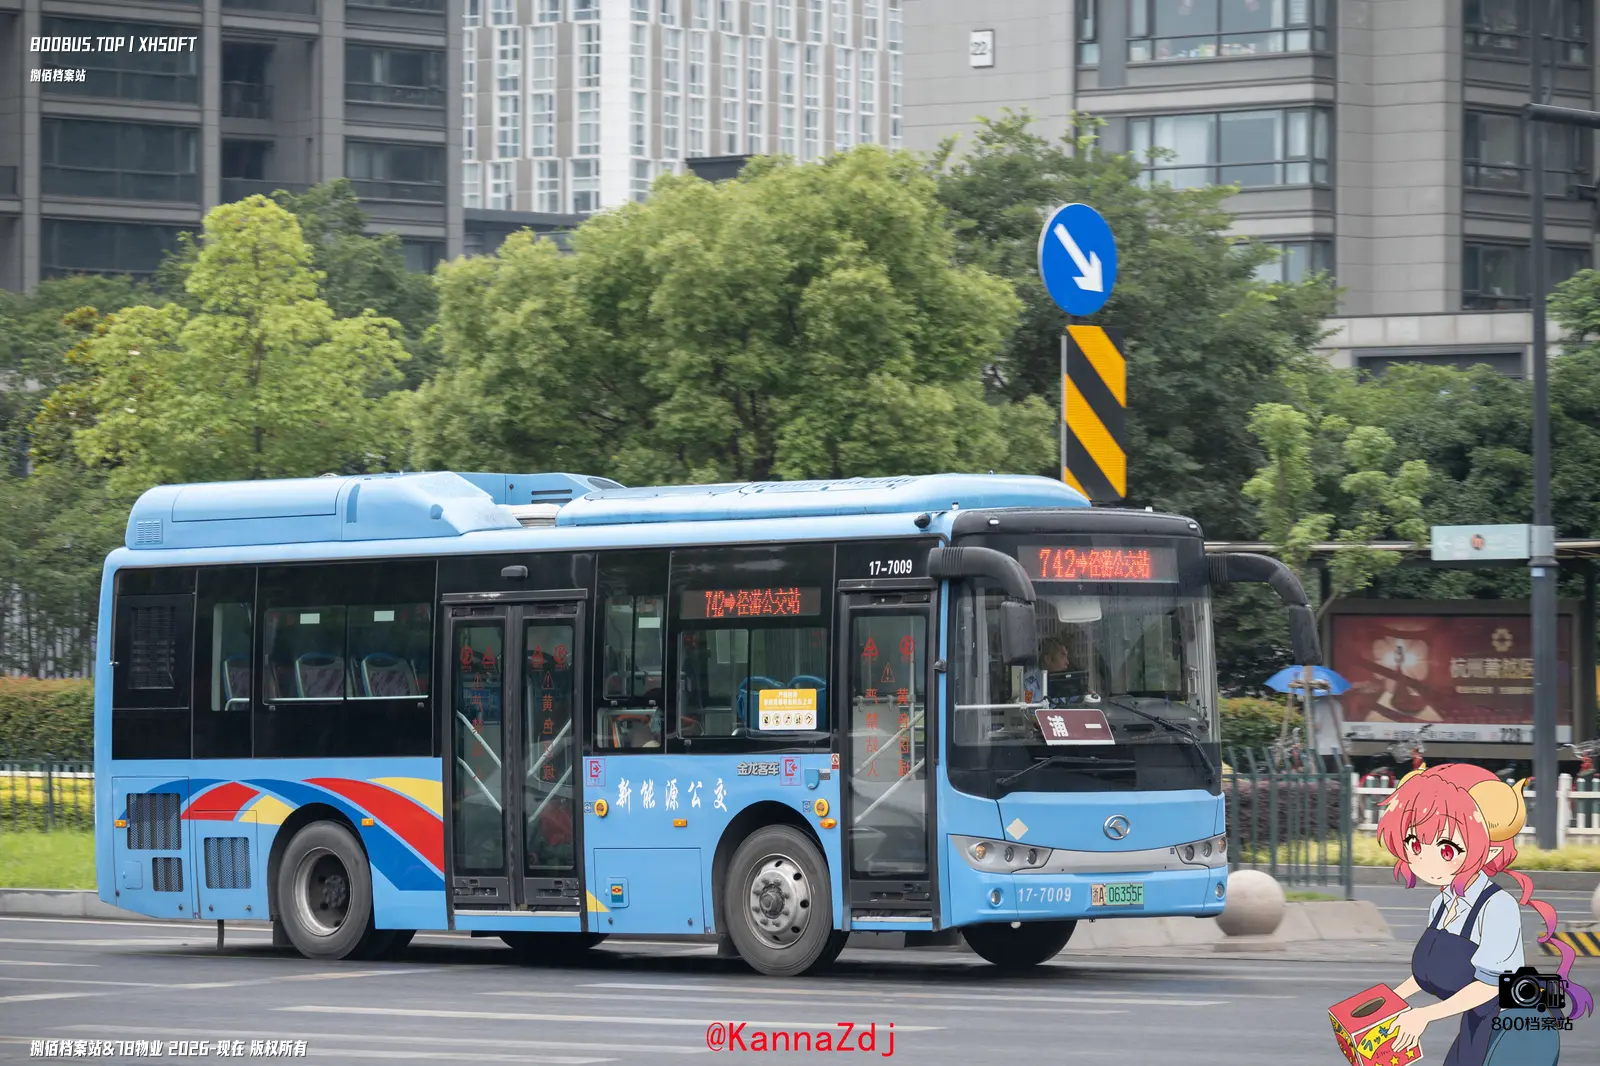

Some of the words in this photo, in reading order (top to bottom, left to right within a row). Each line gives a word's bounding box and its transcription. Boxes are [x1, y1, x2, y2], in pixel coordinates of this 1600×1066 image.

[868, 559, 913, 576] 17-7009
[1039, 549, 1076, 578] 742
[705, 591, 725, 617] 742
[737, 761, 780, 776] 金龙客车
[615, 777, 728, 813] 新能源公交
[1018, 887, 1072, 903] 17-7009
